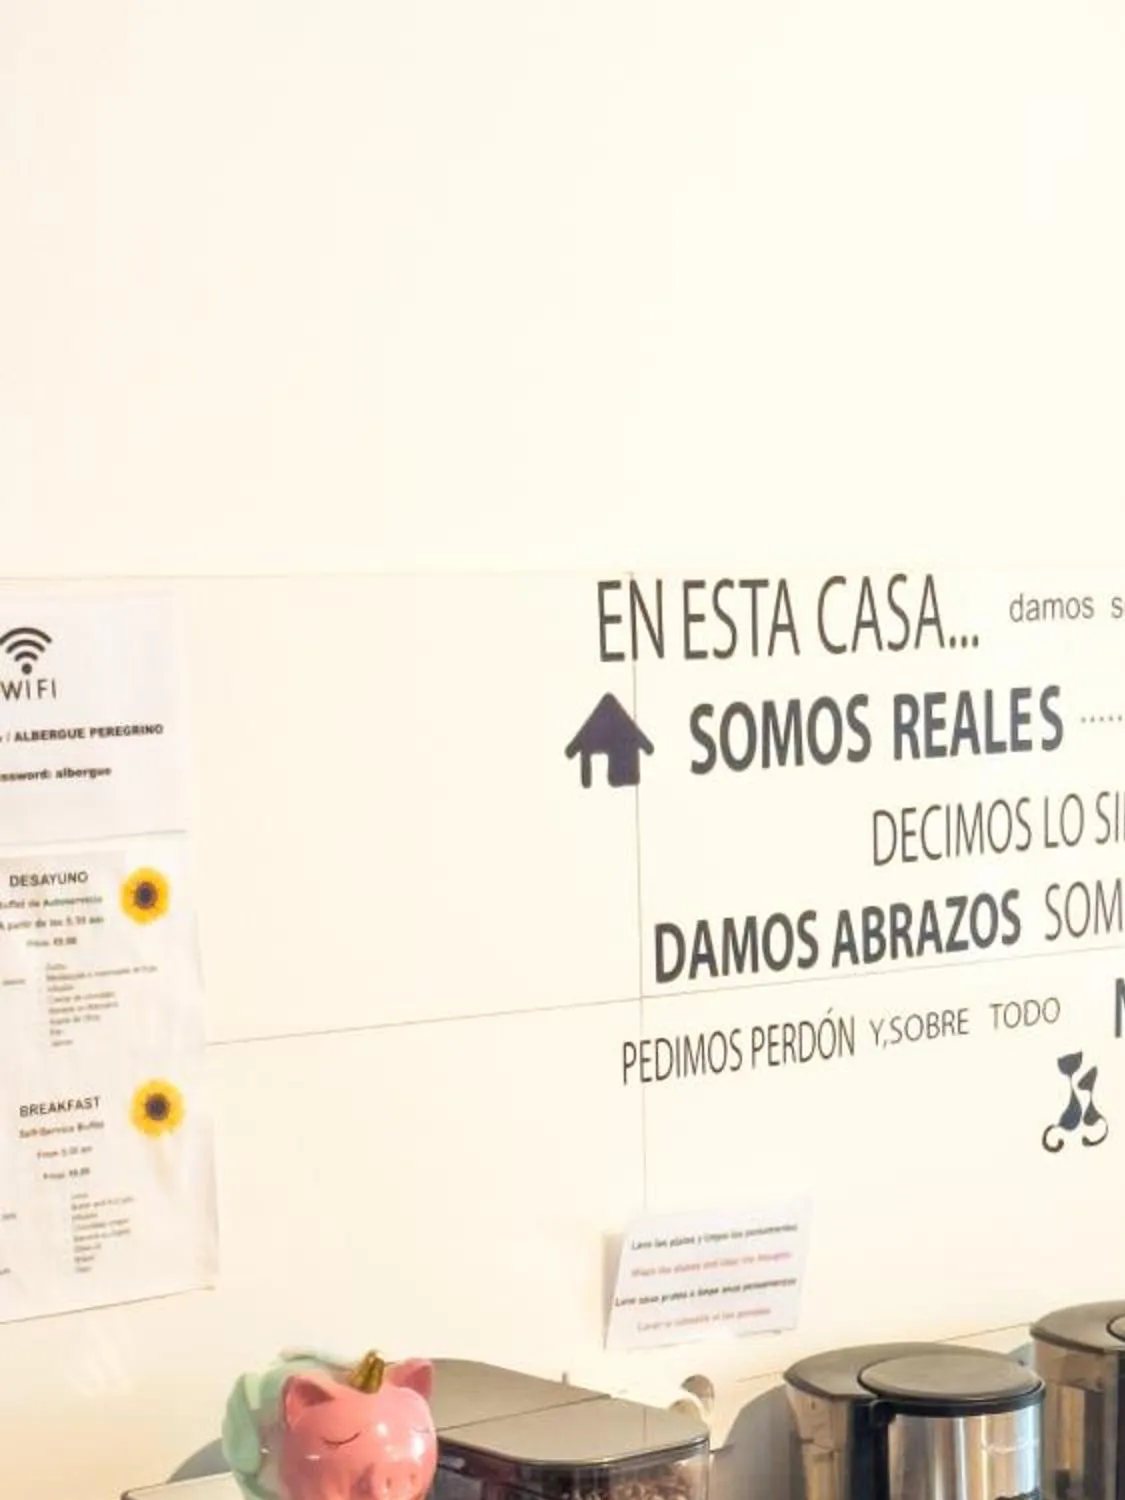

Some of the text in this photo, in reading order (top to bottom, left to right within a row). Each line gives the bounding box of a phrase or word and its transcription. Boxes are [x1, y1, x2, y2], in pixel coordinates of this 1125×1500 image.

[598, 578, 665, 662] EN
[682, 577, 800, 660] ESTA
[1009, 593, 1095, 623] damos
[0, 678, 57, 701] WIFI
[14, 727, 86, 743] ALBERGUE
[89, 722, 165, 739] PEREGRINO
[689, 684, 1065, 776] SOMOS REALES
[55, 766, 112, 780] albergue
[872, 797, 1032, 866] DECIMOS
[1044, 793, 1085, 849] LO
[9, 871, 89, 888] DESAYUNO
[654, 909, 820, 985] DAMOS
[831, 888, 1022, 969] ABRAZOS
[622, 1029, 743, 1086] PEDIMOS
[751, 1008, 857, 1070] PERDÓN
[989, 996, 1062, 1031] TODO
[19, 1096, 101, 1118] BREAKFAST
